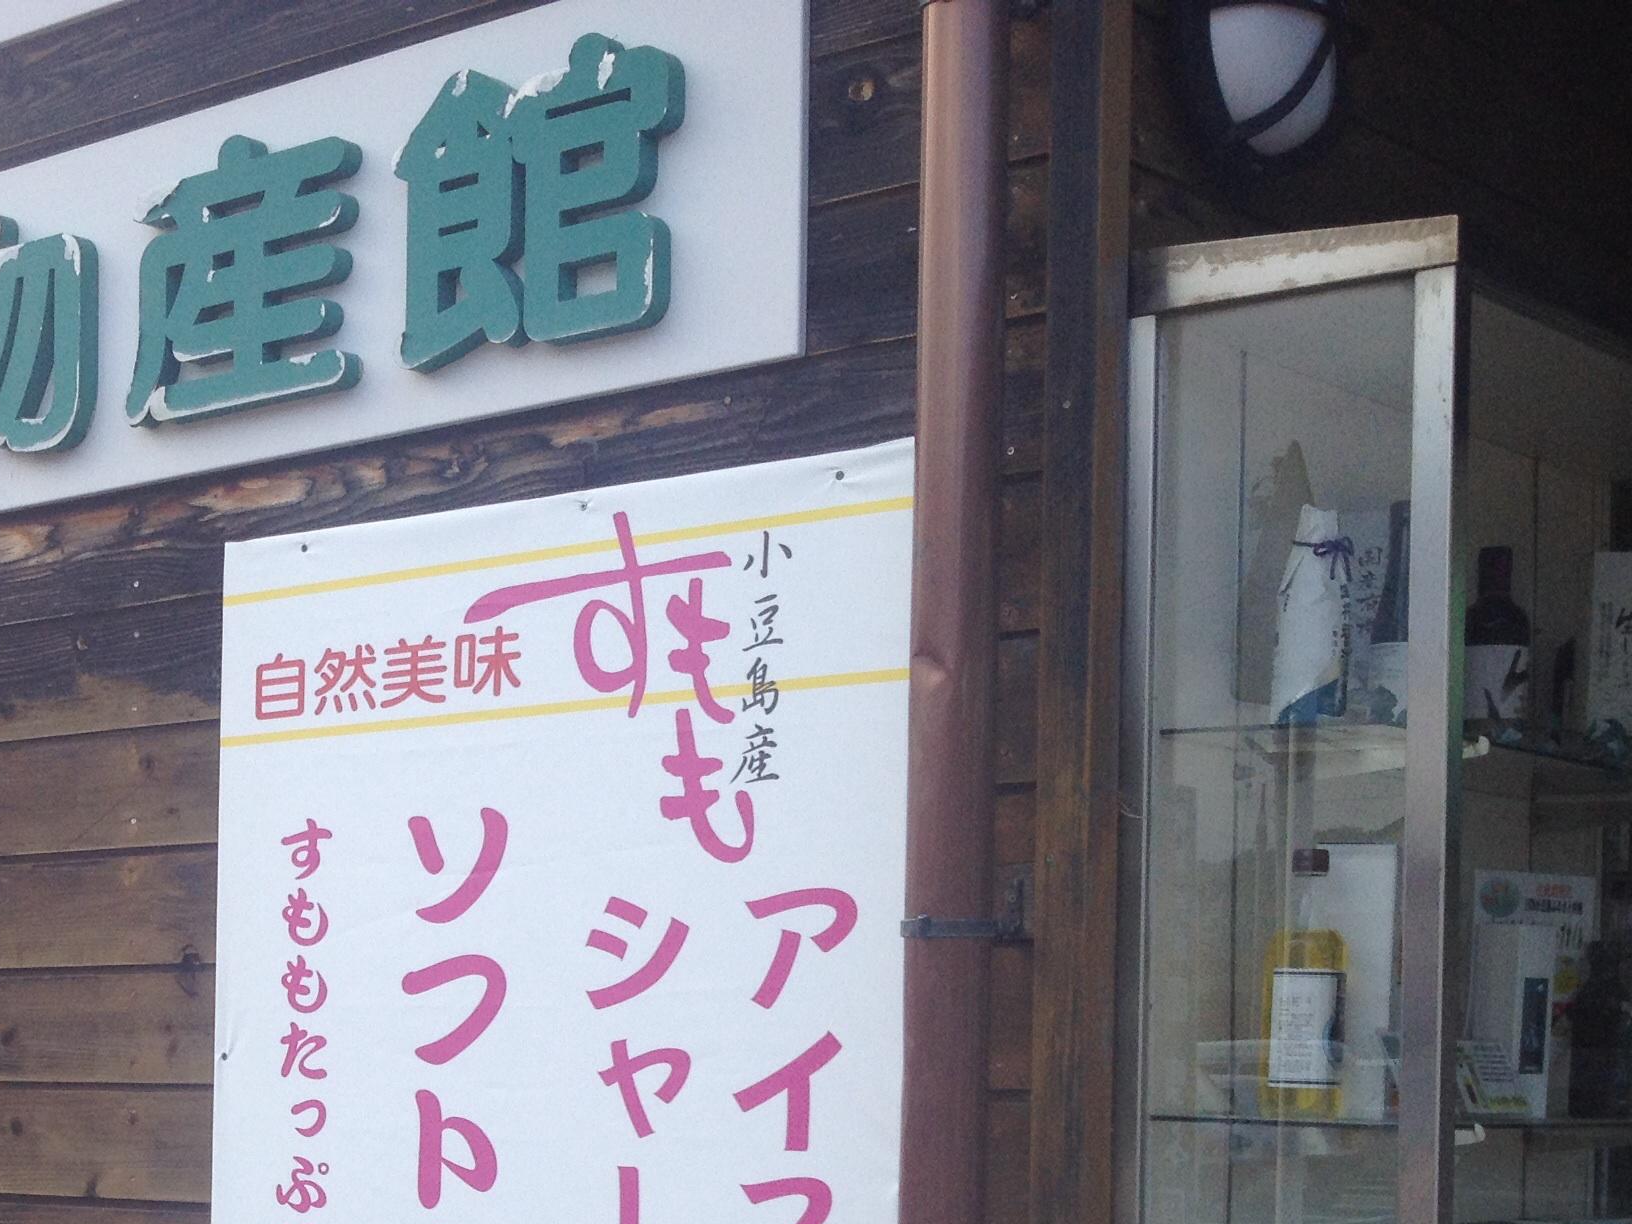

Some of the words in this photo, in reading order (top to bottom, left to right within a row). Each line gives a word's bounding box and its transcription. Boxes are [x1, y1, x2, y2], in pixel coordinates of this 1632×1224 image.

[254, 625, 521, 721] 自然美味
[464, 511, 754, 863] すもも
[730, 530, 792, 785] 小豆島産
